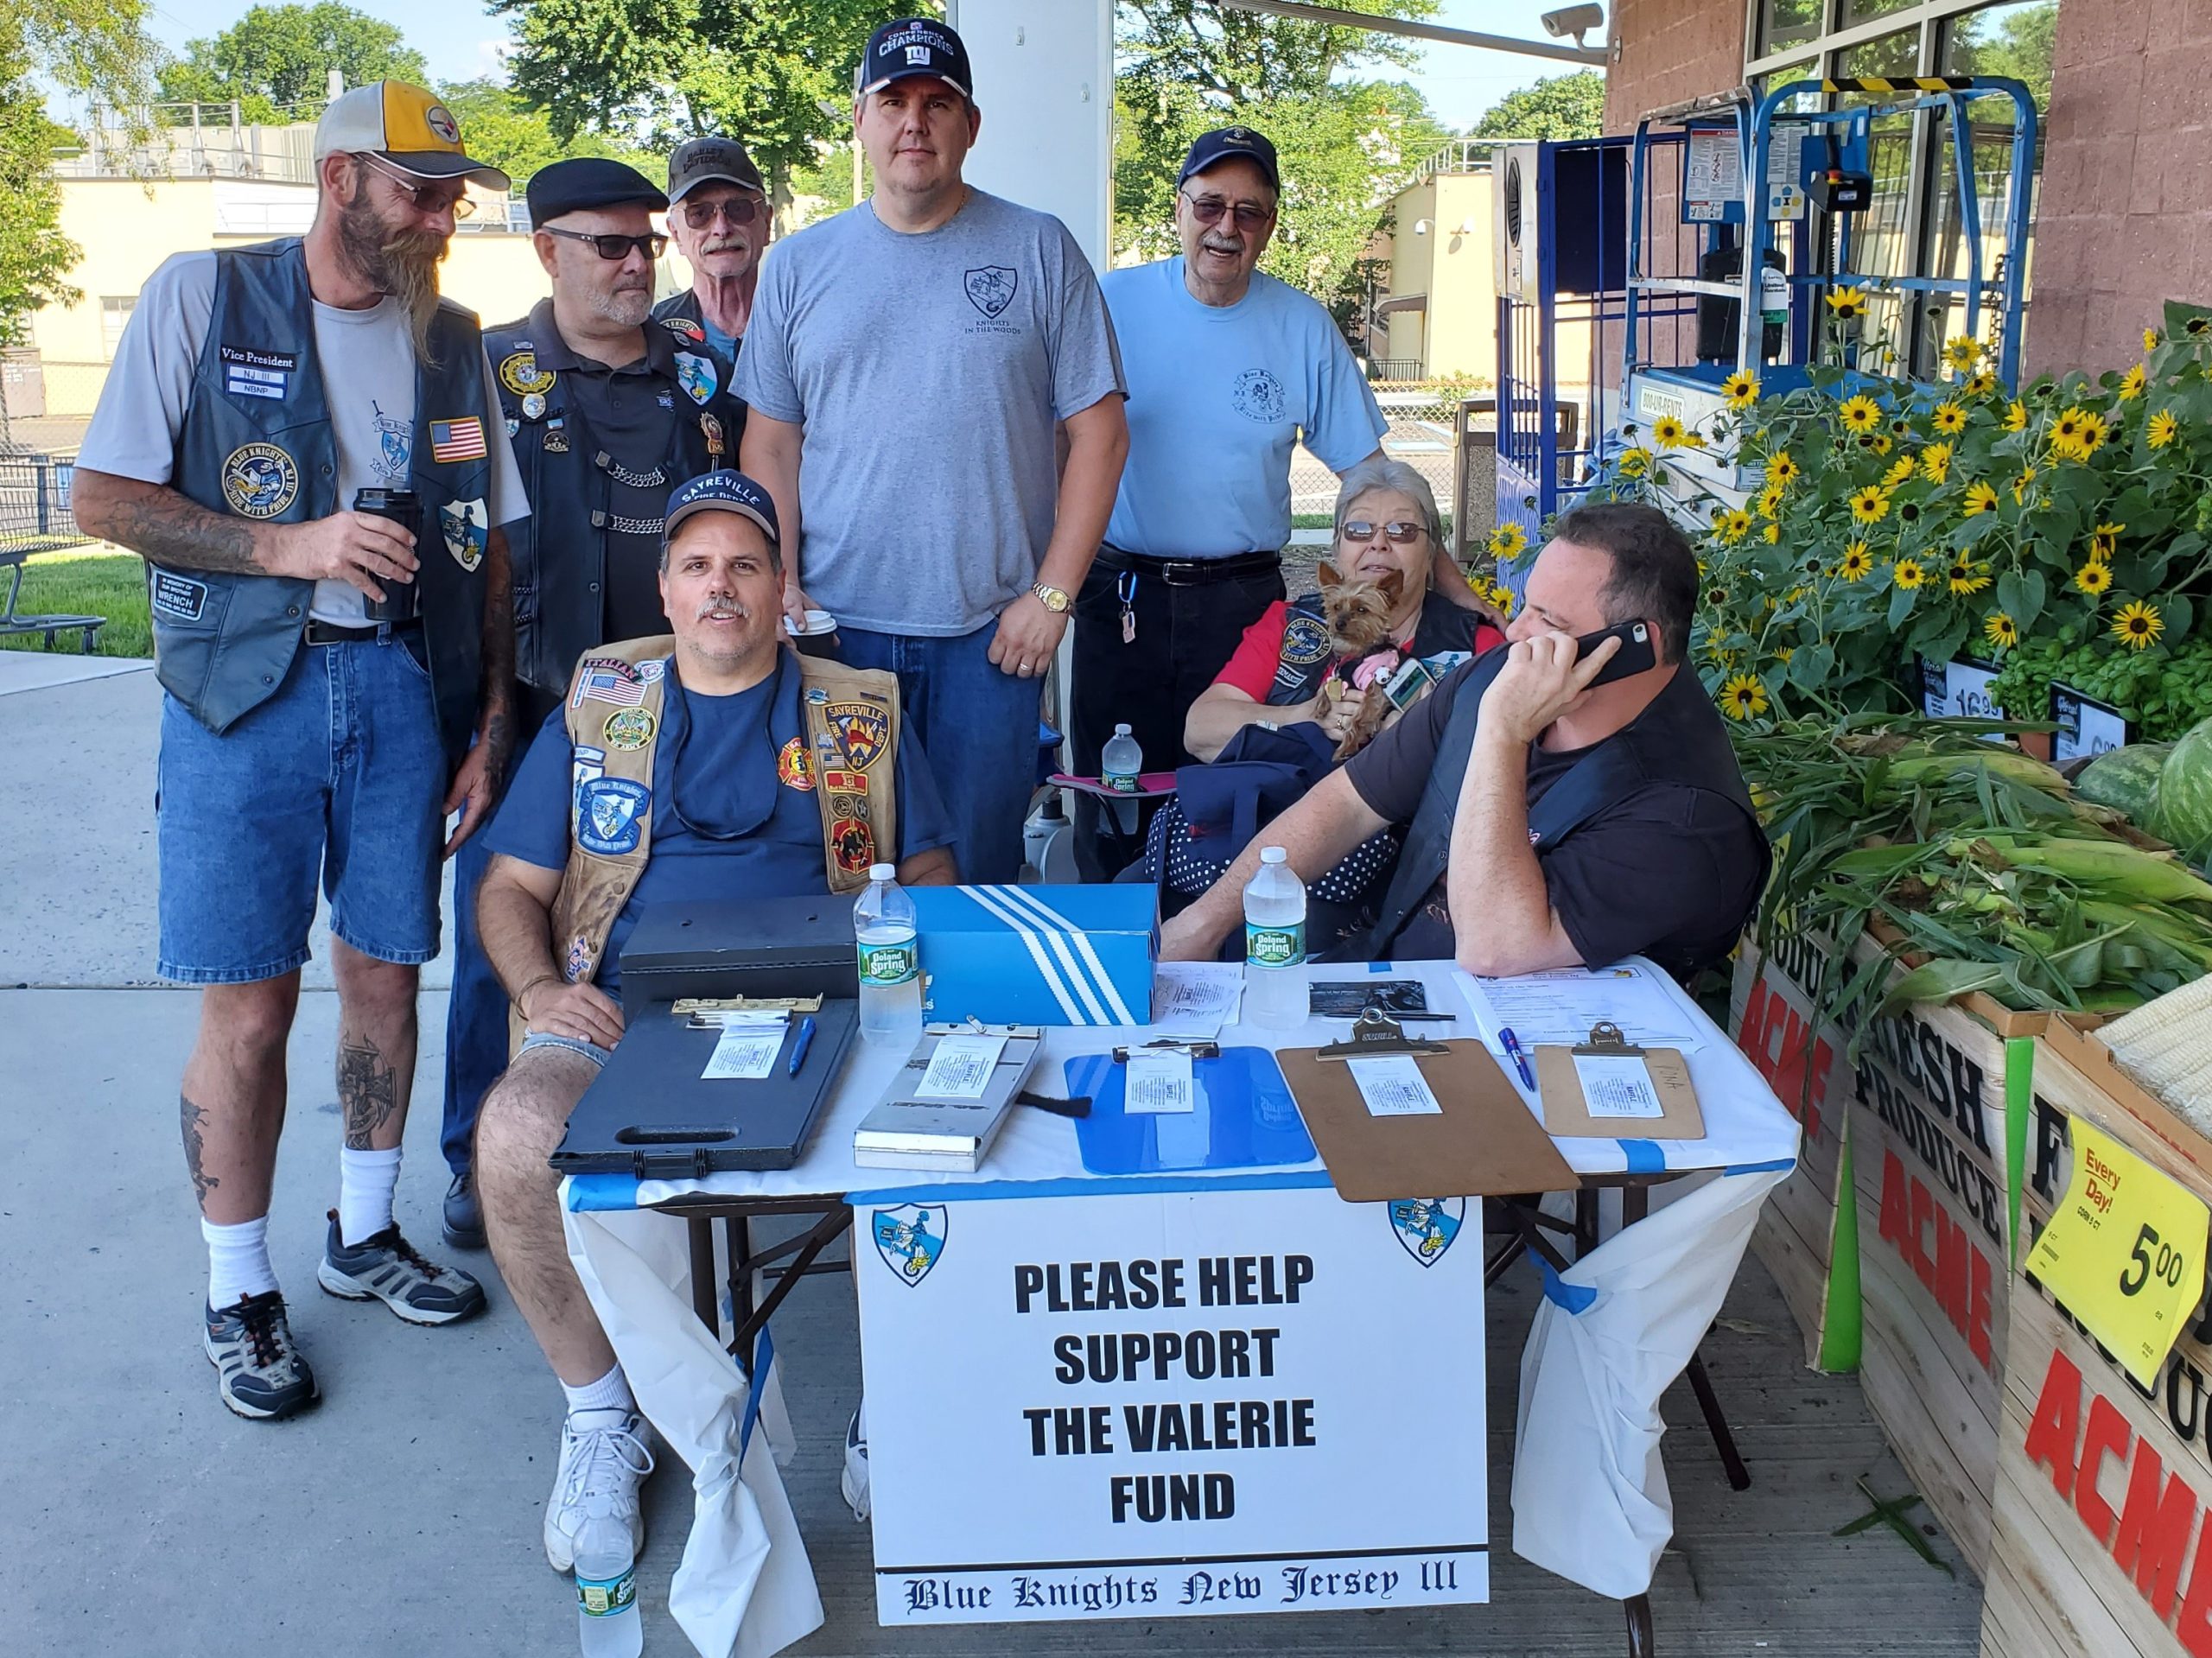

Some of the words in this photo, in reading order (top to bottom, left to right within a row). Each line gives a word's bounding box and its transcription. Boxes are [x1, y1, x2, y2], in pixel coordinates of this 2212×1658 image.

[879, 35, 954, 57] CHAMPIONS
[222, 347, 245, 360] Vice
[246, 352, 293, 367] President
[244, 370, 256, 379] NJ
[244, 384, 268, 394] NBNP
[230, 450, 250, 468] BLUE
[249, 447, 286, 463] KNIGHTS
[681, 476, 760, 505] SAYREVILLE
[228, 490, 245, 507] RIDE
[244, 503, 268, 516] WITH
[269, 494, 289, 513] PRIDE
[158, 589, 194, 609] WRENCH
[586, 658, 639, 679] ITALIAN
[828, 705, 884, 722] SAYREVILLE
[829, 721, 843, 739] FIRE
[852, 756, 864, 767] NJ
[1255, 943, 1291, 957] Spring
[1258, 935, 1287, 944] Poland
[870, 959, 906, 975] Spring
[873, 951, 902, 962] Poland
[1738, 977, 1834, 1140] ACME
[1855, 1051, 2001, 1248] PRODUCE
[2086, 1147, 2121, 1191] Every
[2085, 1178, 2113, 1214] Day!
[2077, 1205, 2090, 1223] CORN
[2093, 1220, 2101, 1230] CT
[1878, 1147, 1993, 1372] ACME
[1014, 1259, 1186, 1313] PLEASE
[1198, 1255, 1314, 1307] HELP
[1053, 1328, 1281, 1384] SUPPORT
[1022, 1406, 1114, 1456] THE
[1122, 1399, 1316, 1452] VALERIE
[1110, 1473, 1236, 1523] FUND
[903, 1578, 992, 1615] Blue
[1011, 1574, 1158, 1611] Knights
[1178, 1571, 1262, 1604] New
[1281, 1566, 1399, 1604] Jersey
